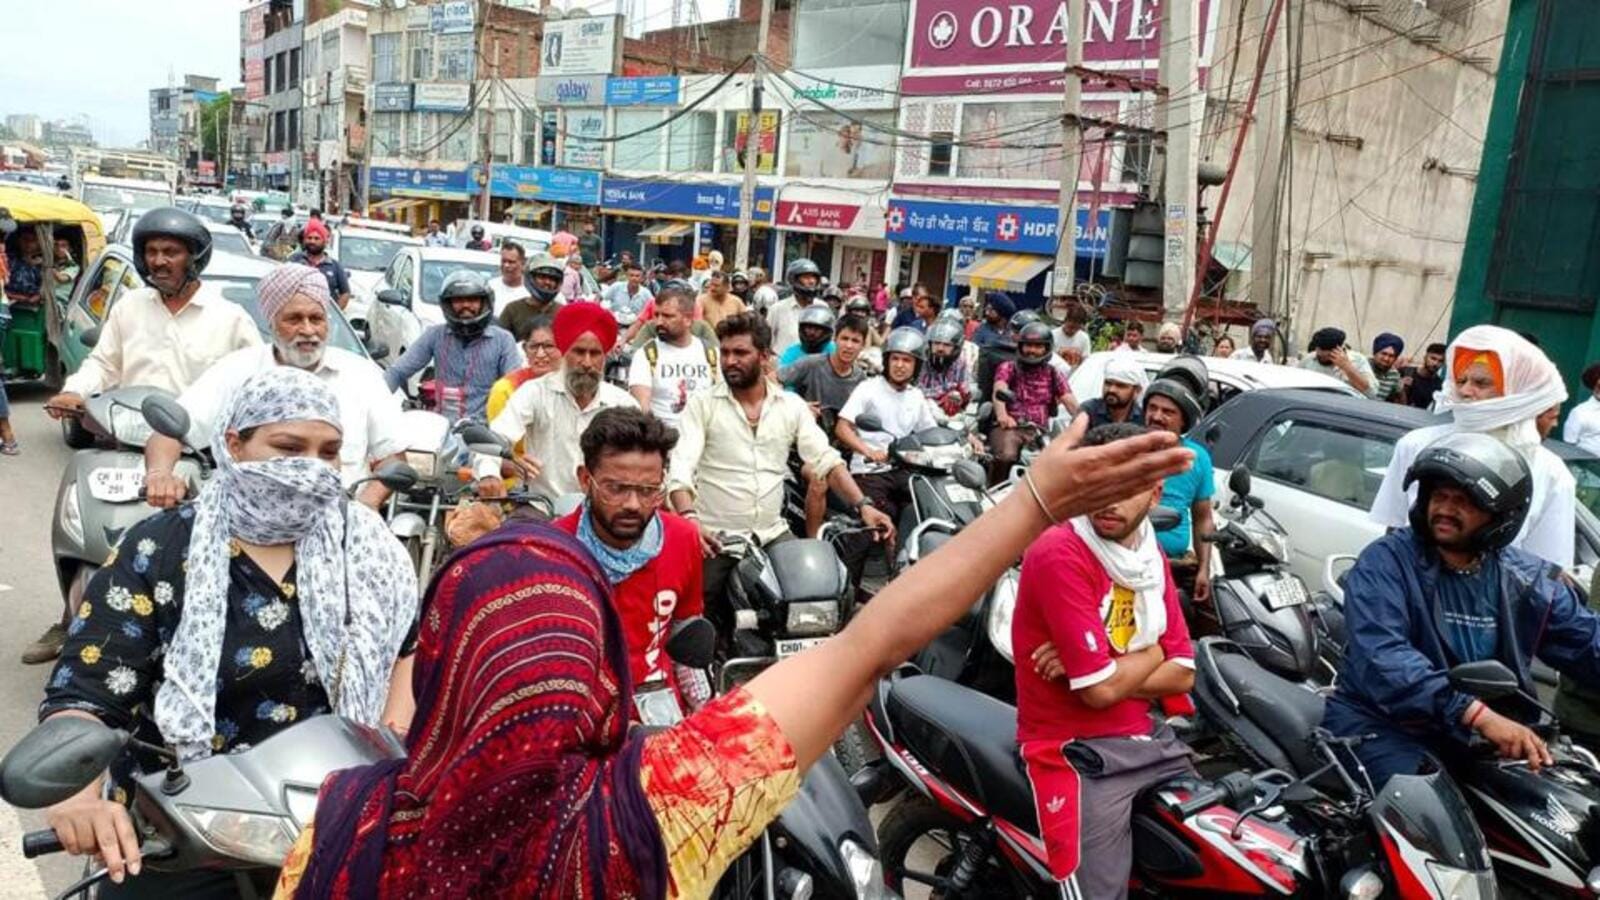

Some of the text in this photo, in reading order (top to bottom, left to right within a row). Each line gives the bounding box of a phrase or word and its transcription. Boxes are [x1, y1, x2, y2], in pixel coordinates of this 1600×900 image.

[556, 79, 591, 102] galaxy
[802, 208, 841, 218] AXIS BANK
[1023, 221, 1060, 238] HDF
[661, 363, 708, 378] DIOR
[1530, 811, 1572, 841] HONDA
